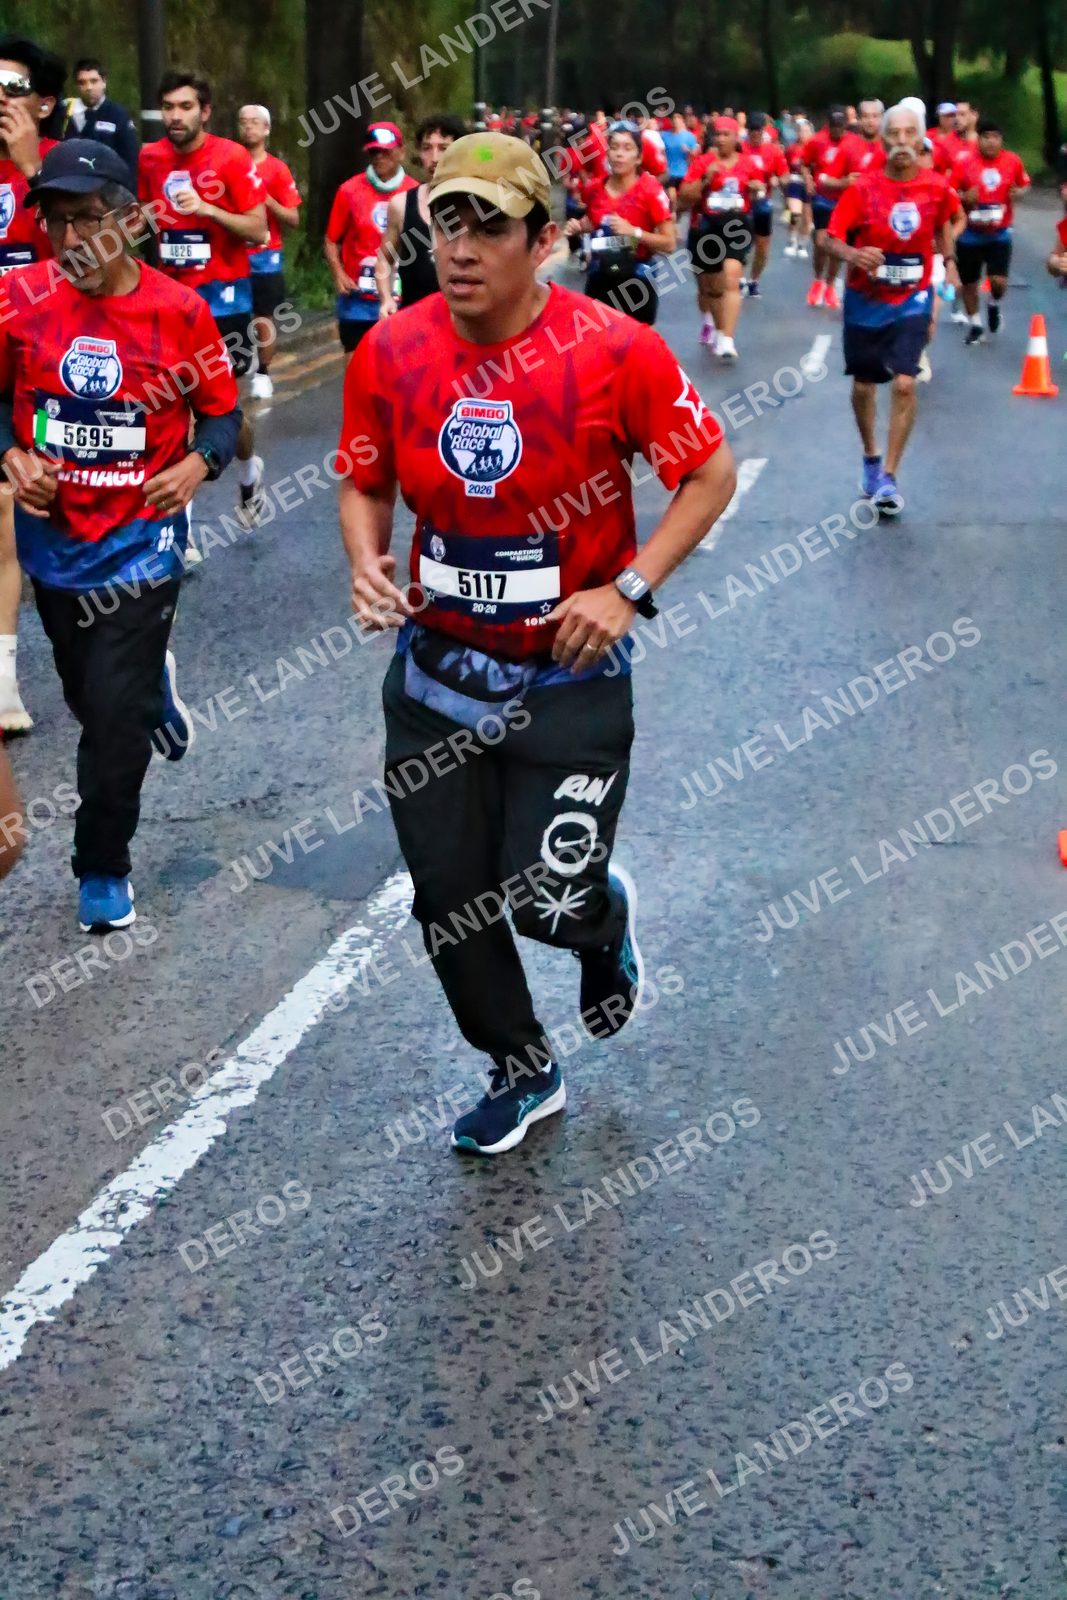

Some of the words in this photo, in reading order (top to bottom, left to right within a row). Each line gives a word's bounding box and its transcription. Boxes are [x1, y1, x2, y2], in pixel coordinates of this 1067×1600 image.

[78, 343, 110, 353] BIMBO
[77, 355, 109, 369] Global
[69, 363, 96, 377] Race
[461, 406, 505, 419] BIMBO
[64, 424, 113, 448] 5695
[460, 422, 503, 439] Global
[451, 435, 486, 451] Race
[468, 484, 493, 495] 2026
[458, 571, 507, 600] 5117
[472, 603, 497, 615] 20-26
[524, 616, 547, 627] 10K
